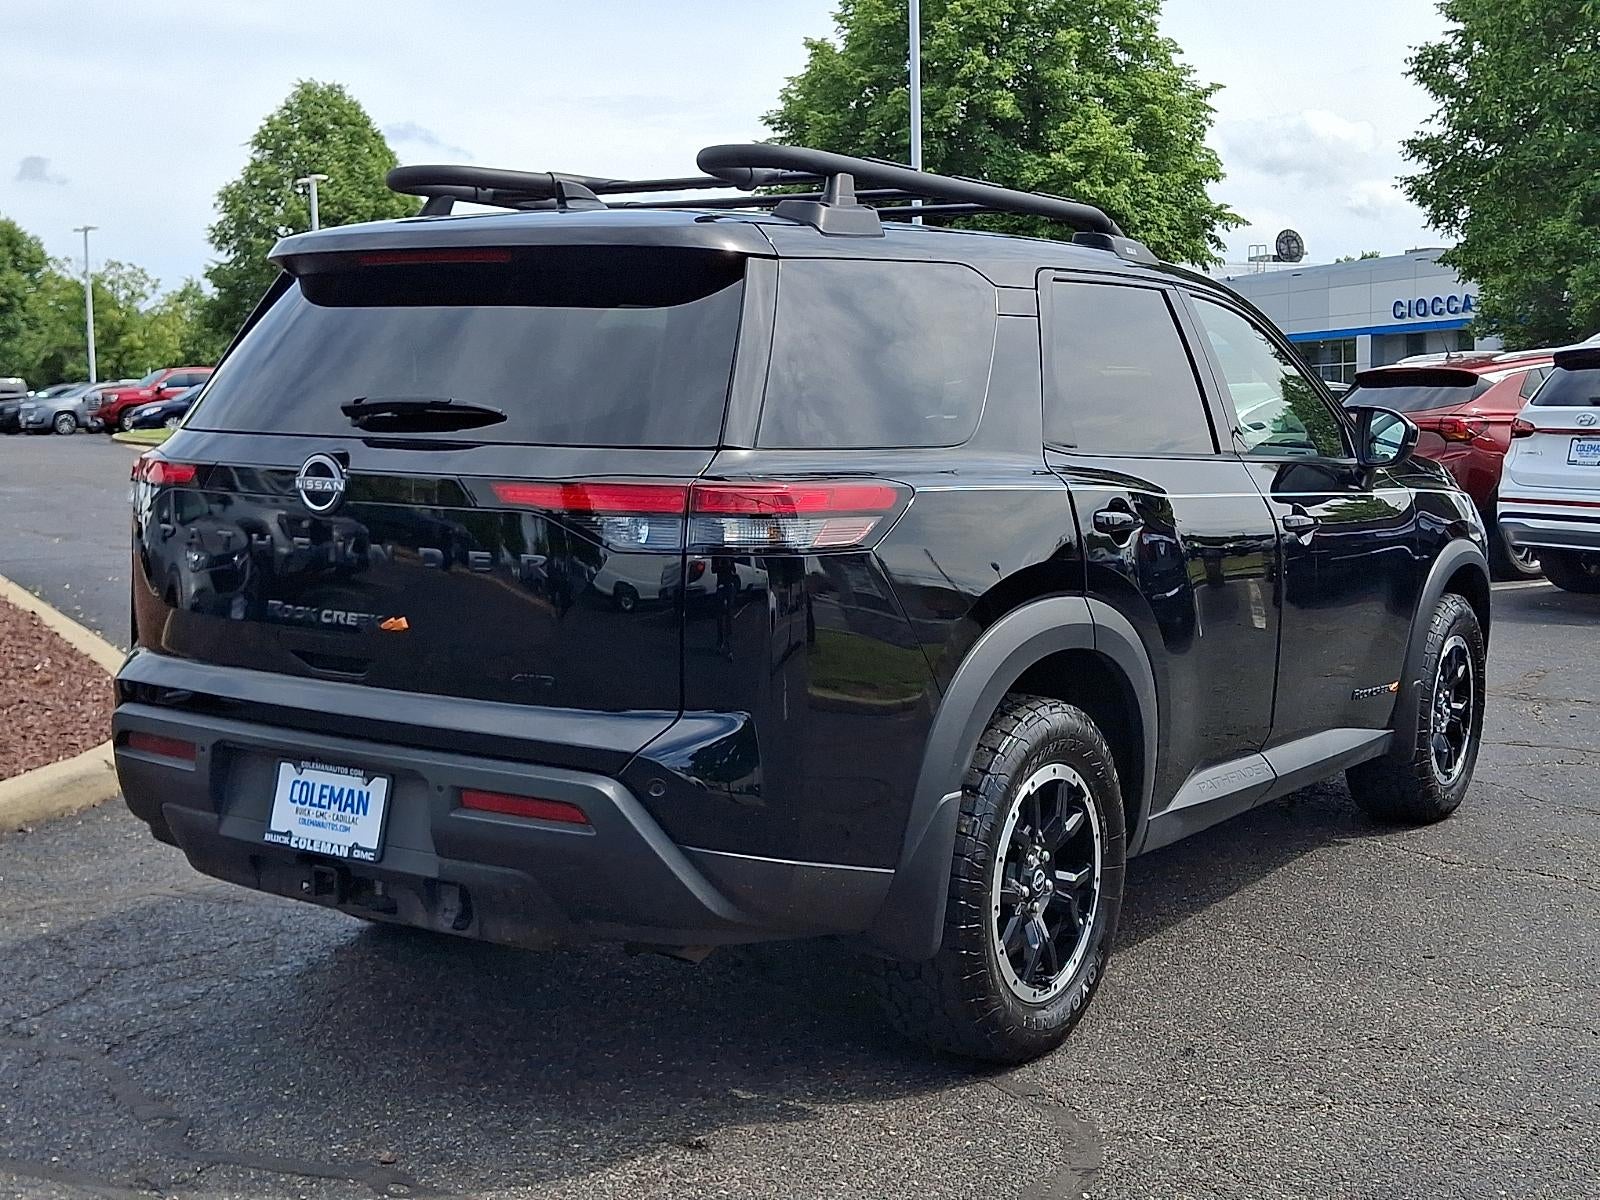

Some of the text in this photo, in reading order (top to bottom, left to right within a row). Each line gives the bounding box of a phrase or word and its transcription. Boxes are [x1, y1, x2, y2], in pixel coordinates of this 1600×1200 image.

[1392, 293, 1474, 319] CIOCCA
[295, 479, 344, 491] NISSAN
[159, 522, 550, 578] PATHFINDER
[289, 779, 370, 816] COLEMAN
[295, 806, 359, 826] BUICK GMC CADILLAC
[298, 817, 351, 833] COLEMANAUTOS.COM
[264, 832, 375, 861] BUICK COLEMAN GMC
